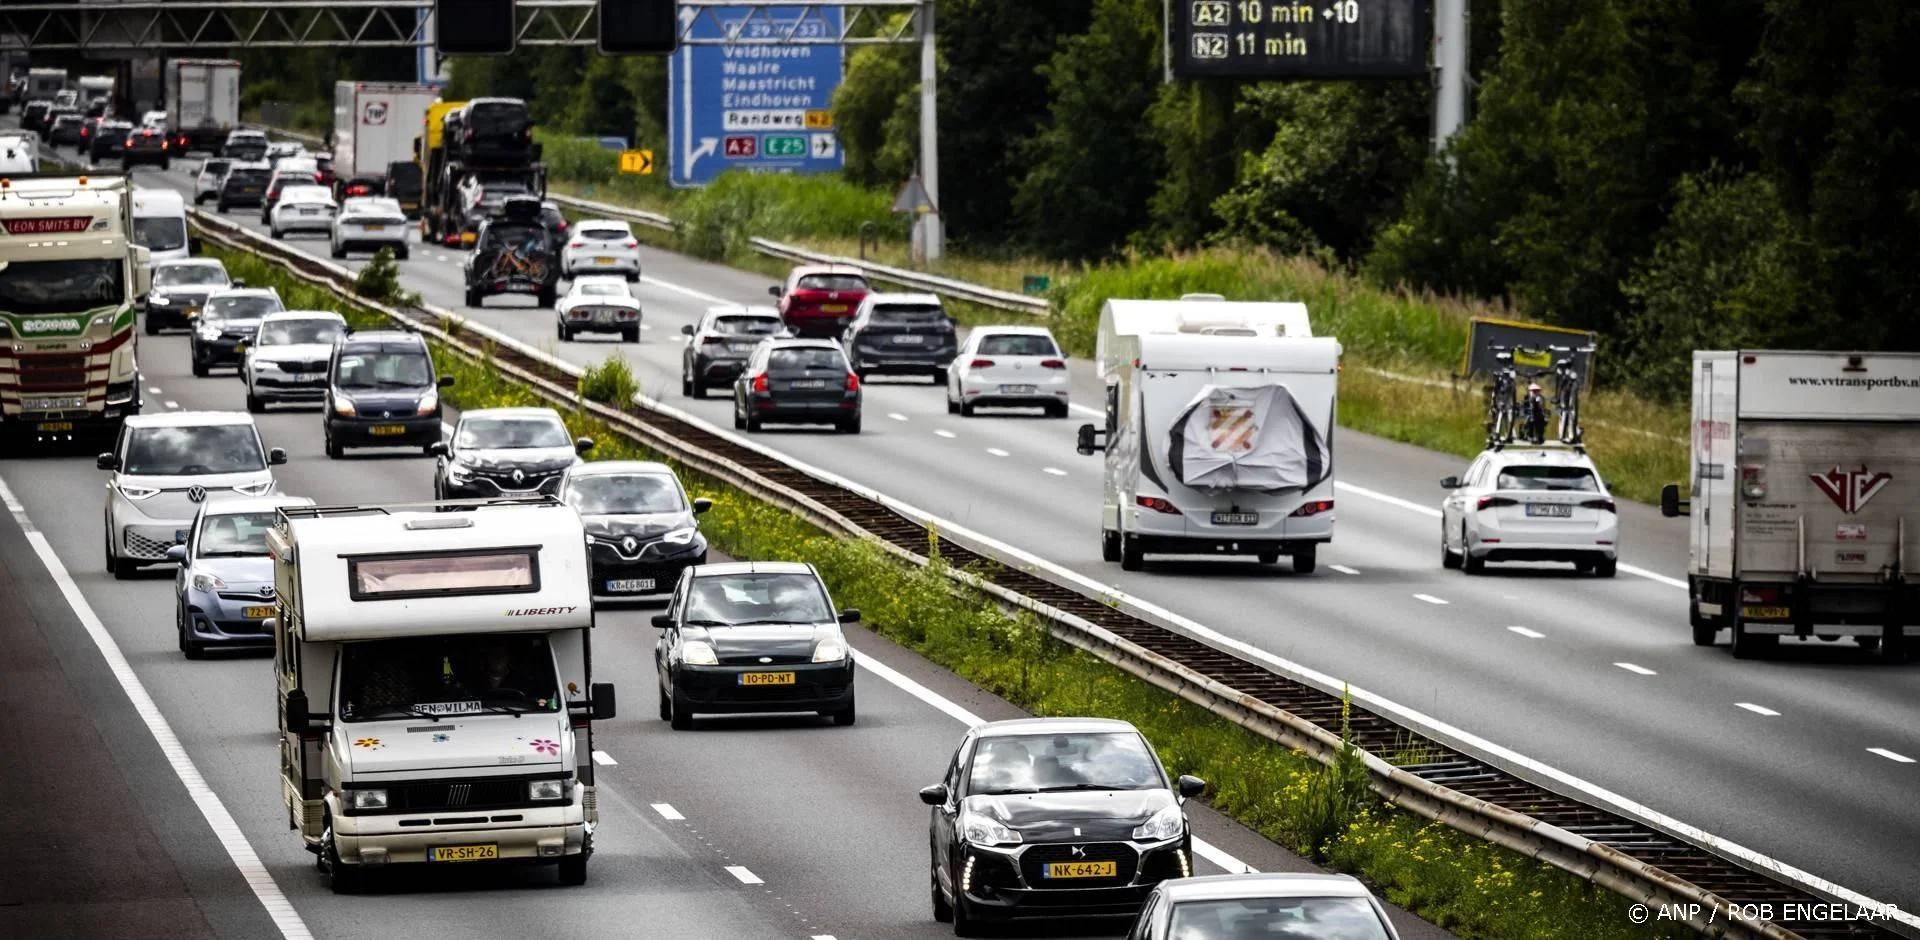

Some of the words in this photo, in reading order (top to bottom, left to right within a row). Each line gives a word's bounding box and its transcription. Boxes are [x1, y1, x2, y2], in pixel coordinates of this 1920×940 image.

[1197, 4, 1225, 23] A2
[1238, 1, 1262, 23] 10
[1271, 1, 1313, 23] min
[1197, 38, 1223, 56] N2
[1236, 33, 1256, 55] 11
[1265, 33, 1307, 55] min
[722, 45, 811, 59] Veldhoven
[723, 61, 780, 75] Waalre
[722, 76, 816, 91] Maastricht
[722, 92, 813, 108] Eindhoven
[728, 112, 804, 127] Randweg
[728, 140, 754, 154] A2
[8, 221, 35, 233] LEON
[38, 219, 70, 232] SMITS
[73, 219, 88, 230] BV
[514, 606, 577, 617] LIBERTY
[746, 673, 793, 684] 10-PD-NT
[445, 701, 481, 713] WILMA
[438, 846, 494, 859] VR-SH-26
[1054, 863, 1112, 877] NK-642-J
